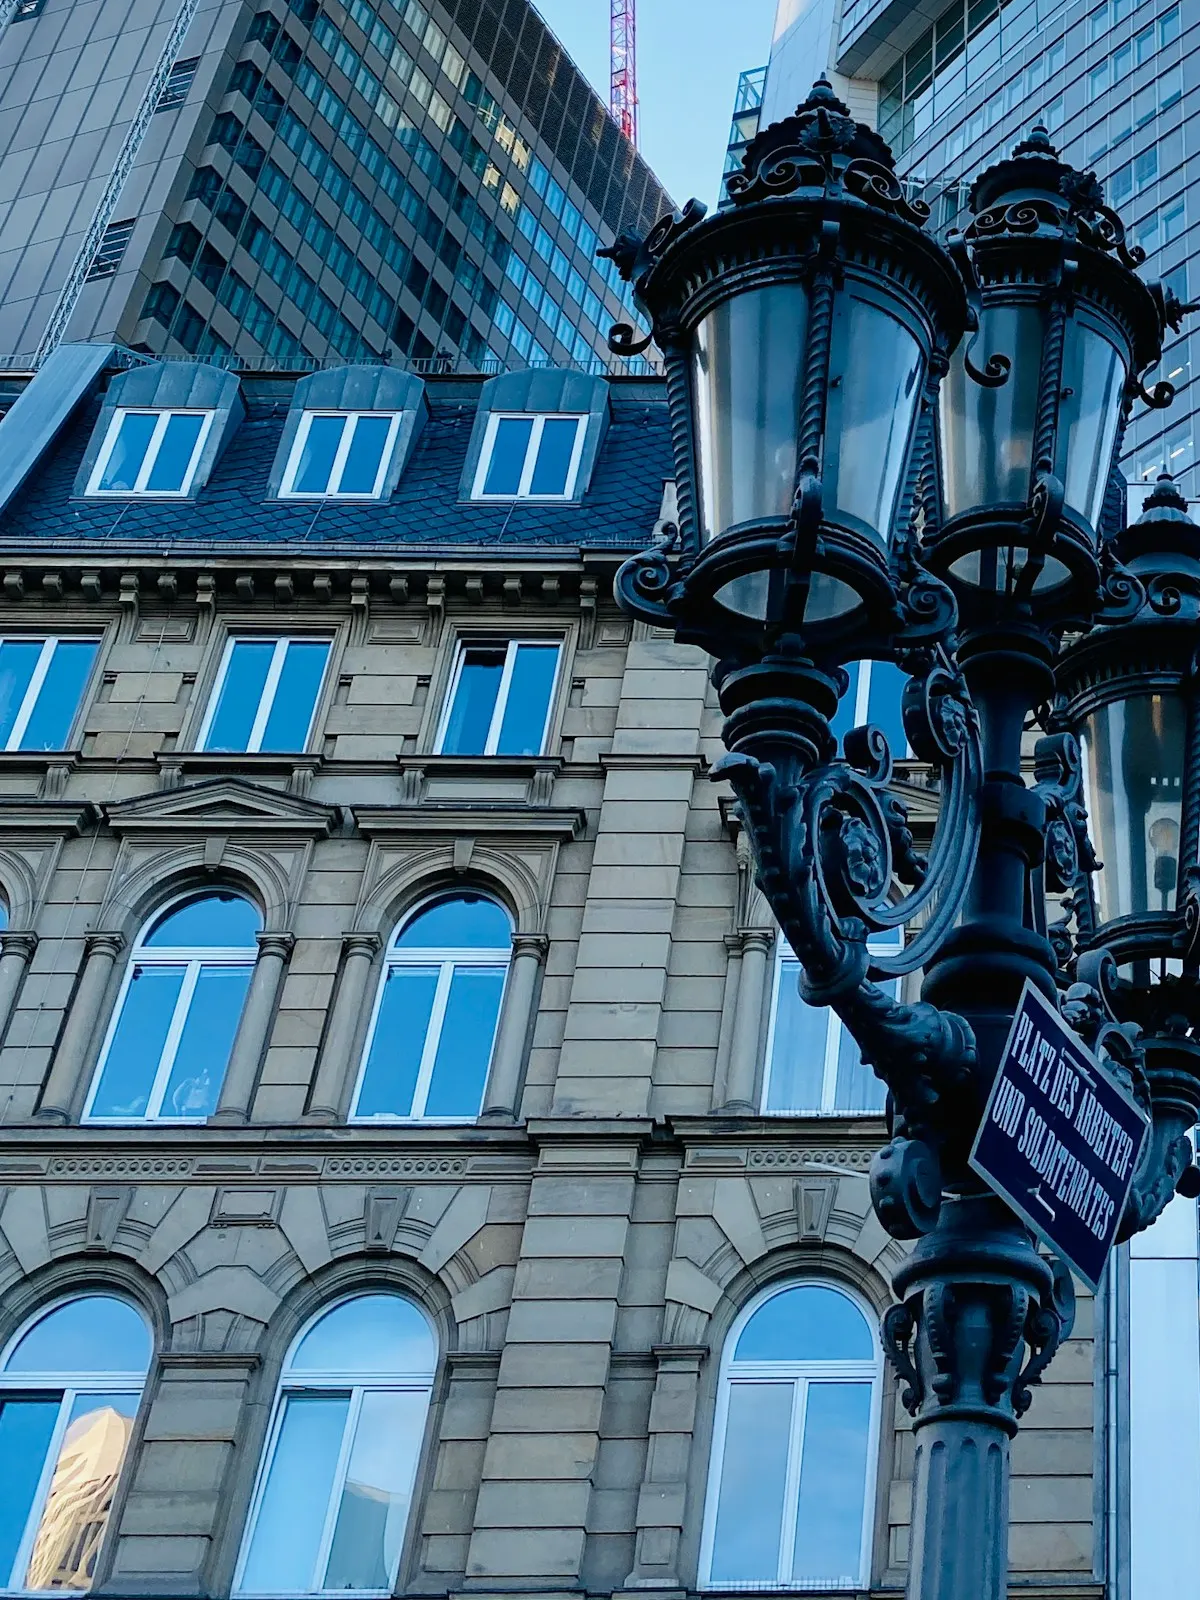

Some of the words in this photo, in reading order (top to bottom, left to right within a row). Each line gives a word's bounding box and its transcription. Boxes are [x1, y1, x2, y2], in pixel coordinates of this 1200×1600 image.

[992, 1076, 1025, 1138] UND
[1018, 1106, 1115, 1240] SOLDATENRATES
[1011, 1011, 1056, 1094] PLATZ
[1048, 1058, 1079, 1119] DES
[1073, 1088, 1133, 1181] ARBEITER-
